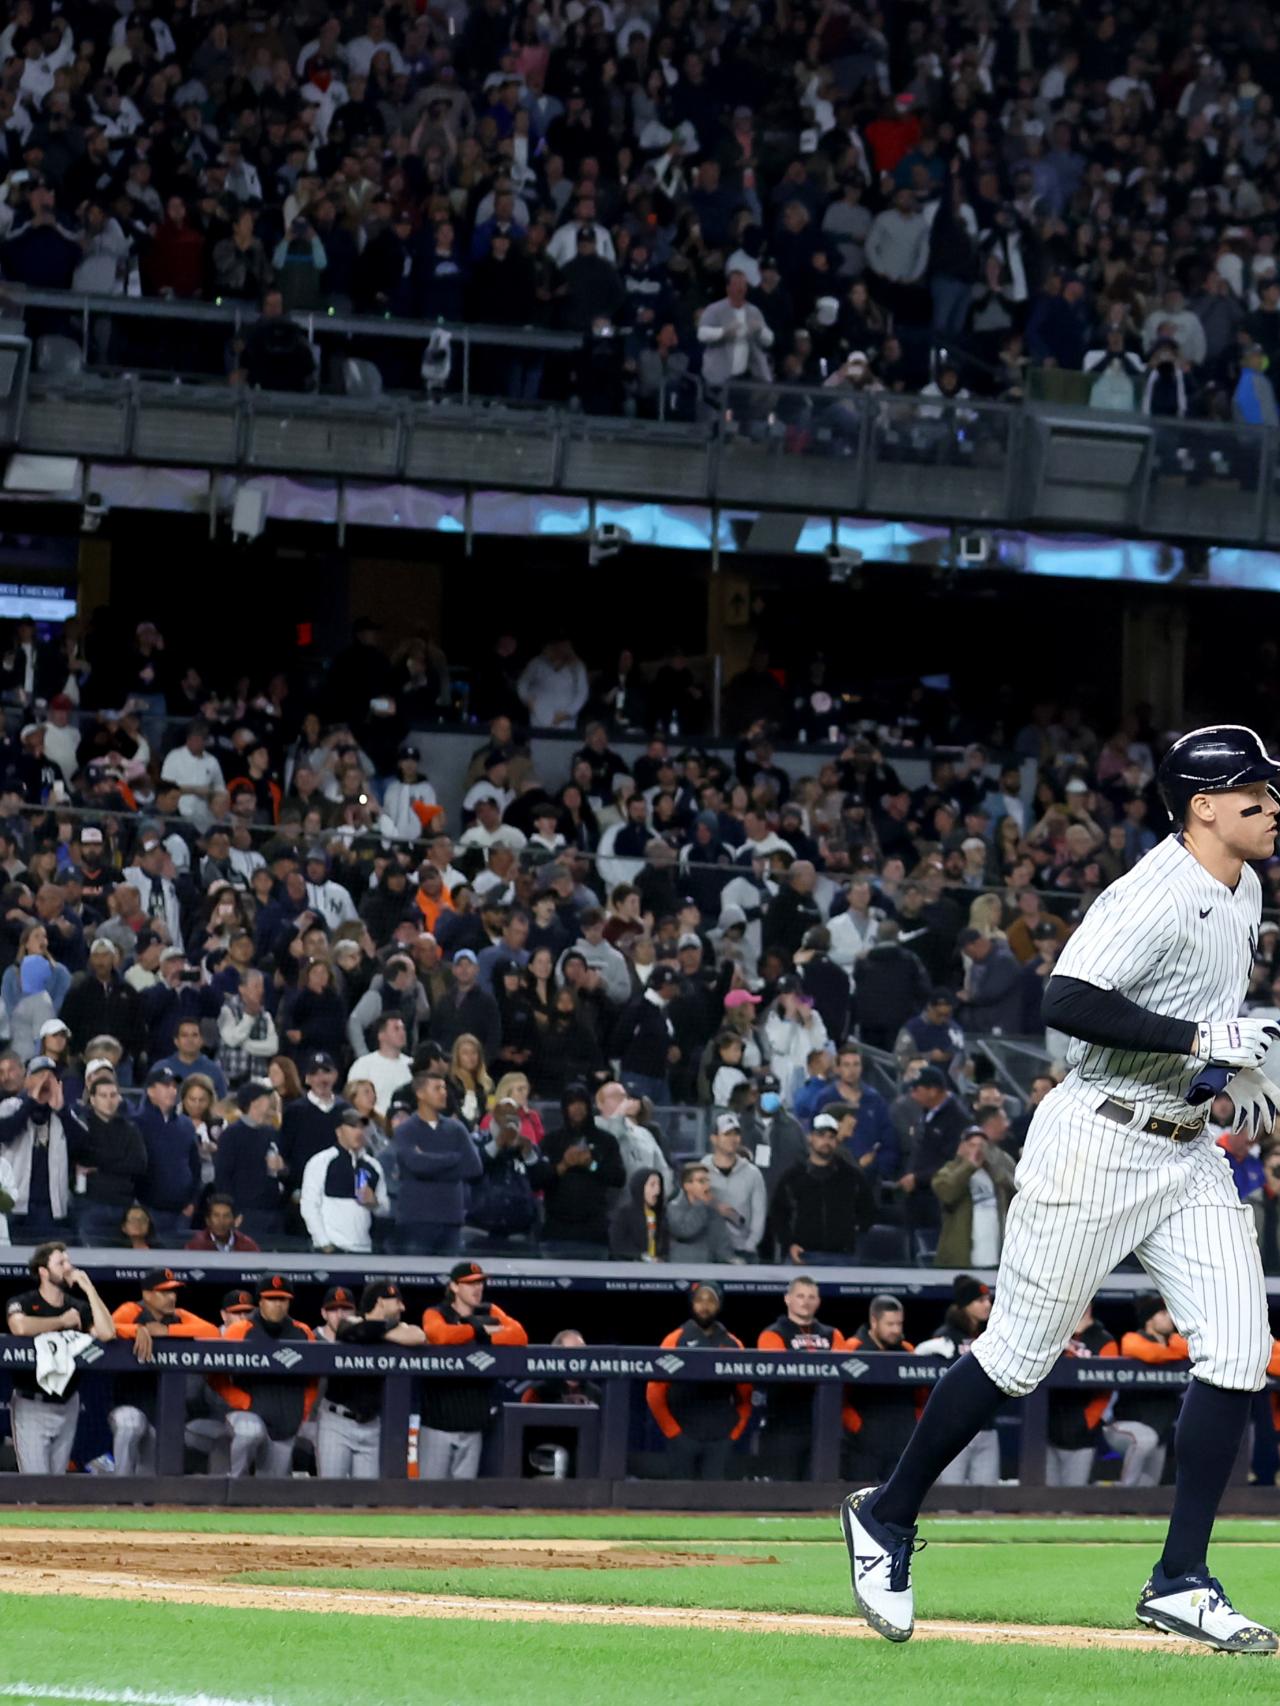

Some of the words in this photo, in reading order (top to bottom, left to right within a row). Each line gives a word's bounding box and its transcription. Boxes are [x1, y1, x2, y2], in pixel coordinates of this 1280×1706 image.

[486, 1279, 508, 1287] BANK
[181, 1352, 200, 1366] OF
[203, 1353, 270, 1367] AMERICA
[334, 1355, 374, 1369] BANK
[377, 1356, 396, 1369] OF
[399, 1357, 465, 1370] AMERICA
[527, 1359, 566, 1372] BANK
[568, 1359, 587, 1372] OF
[590, 1360, 654, 1373] AMERICA
[714, 1362, 754, 1375] BANK
[755, 1363, 774, 1376] OF
[776, 1364, 840, 1377] AMERICA
[898, 1366, 937, 1378] BANK
[1077, 1369, 1115, 1382] BANK
[1116, 1370, 1134, 1383] OF
